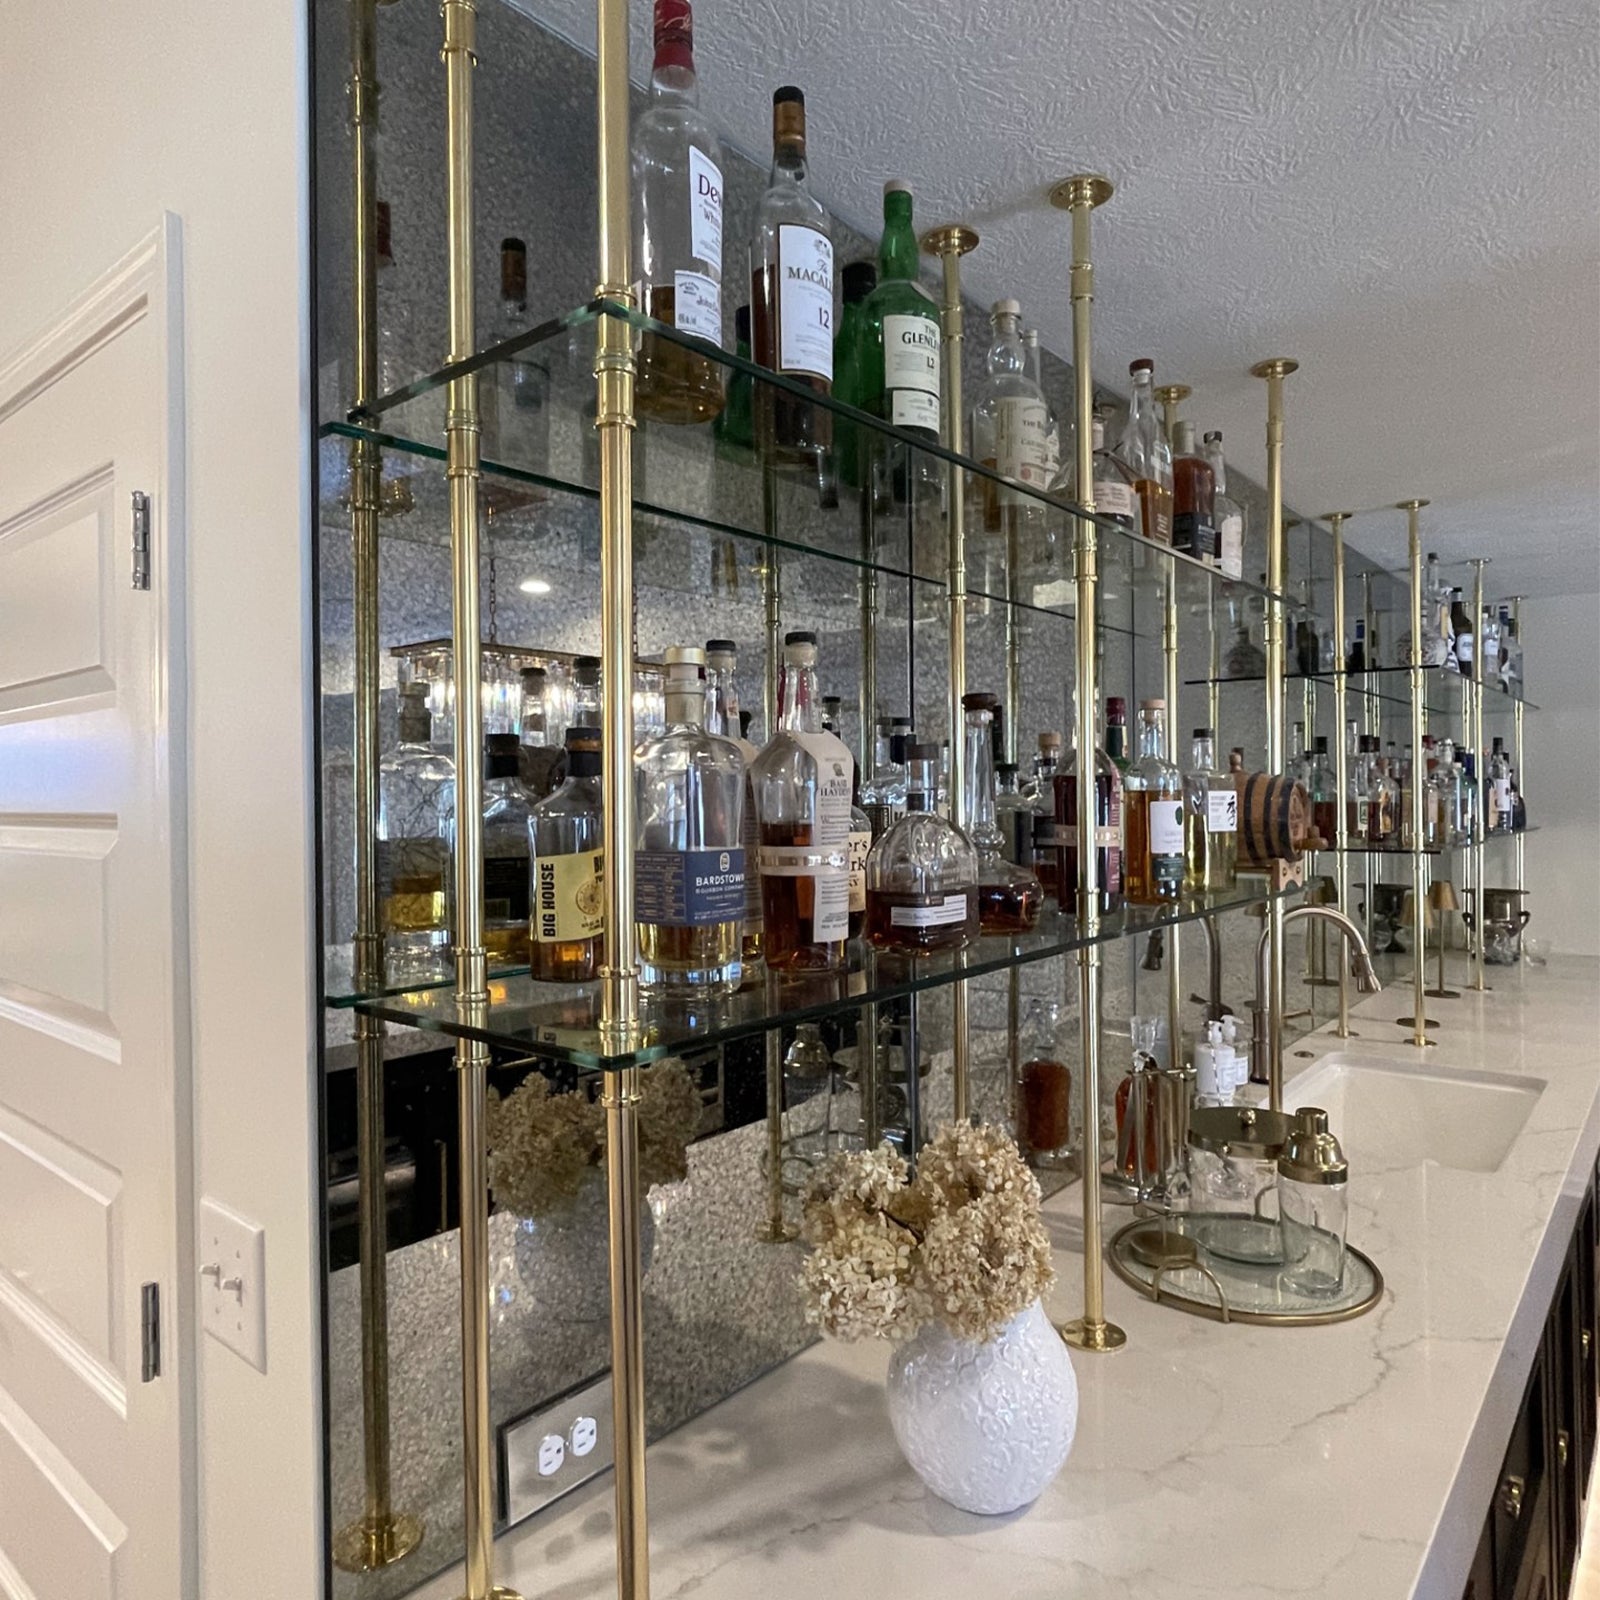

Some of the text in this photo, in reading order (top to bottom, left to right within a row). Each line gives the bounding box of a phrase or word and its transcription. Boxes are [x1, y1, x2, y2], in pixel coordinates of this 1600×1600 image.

[818, 307, 831, 330] 12
[926, 356, 936, 370] 12
[541, 863, 556, 937] BIG HOUSE
